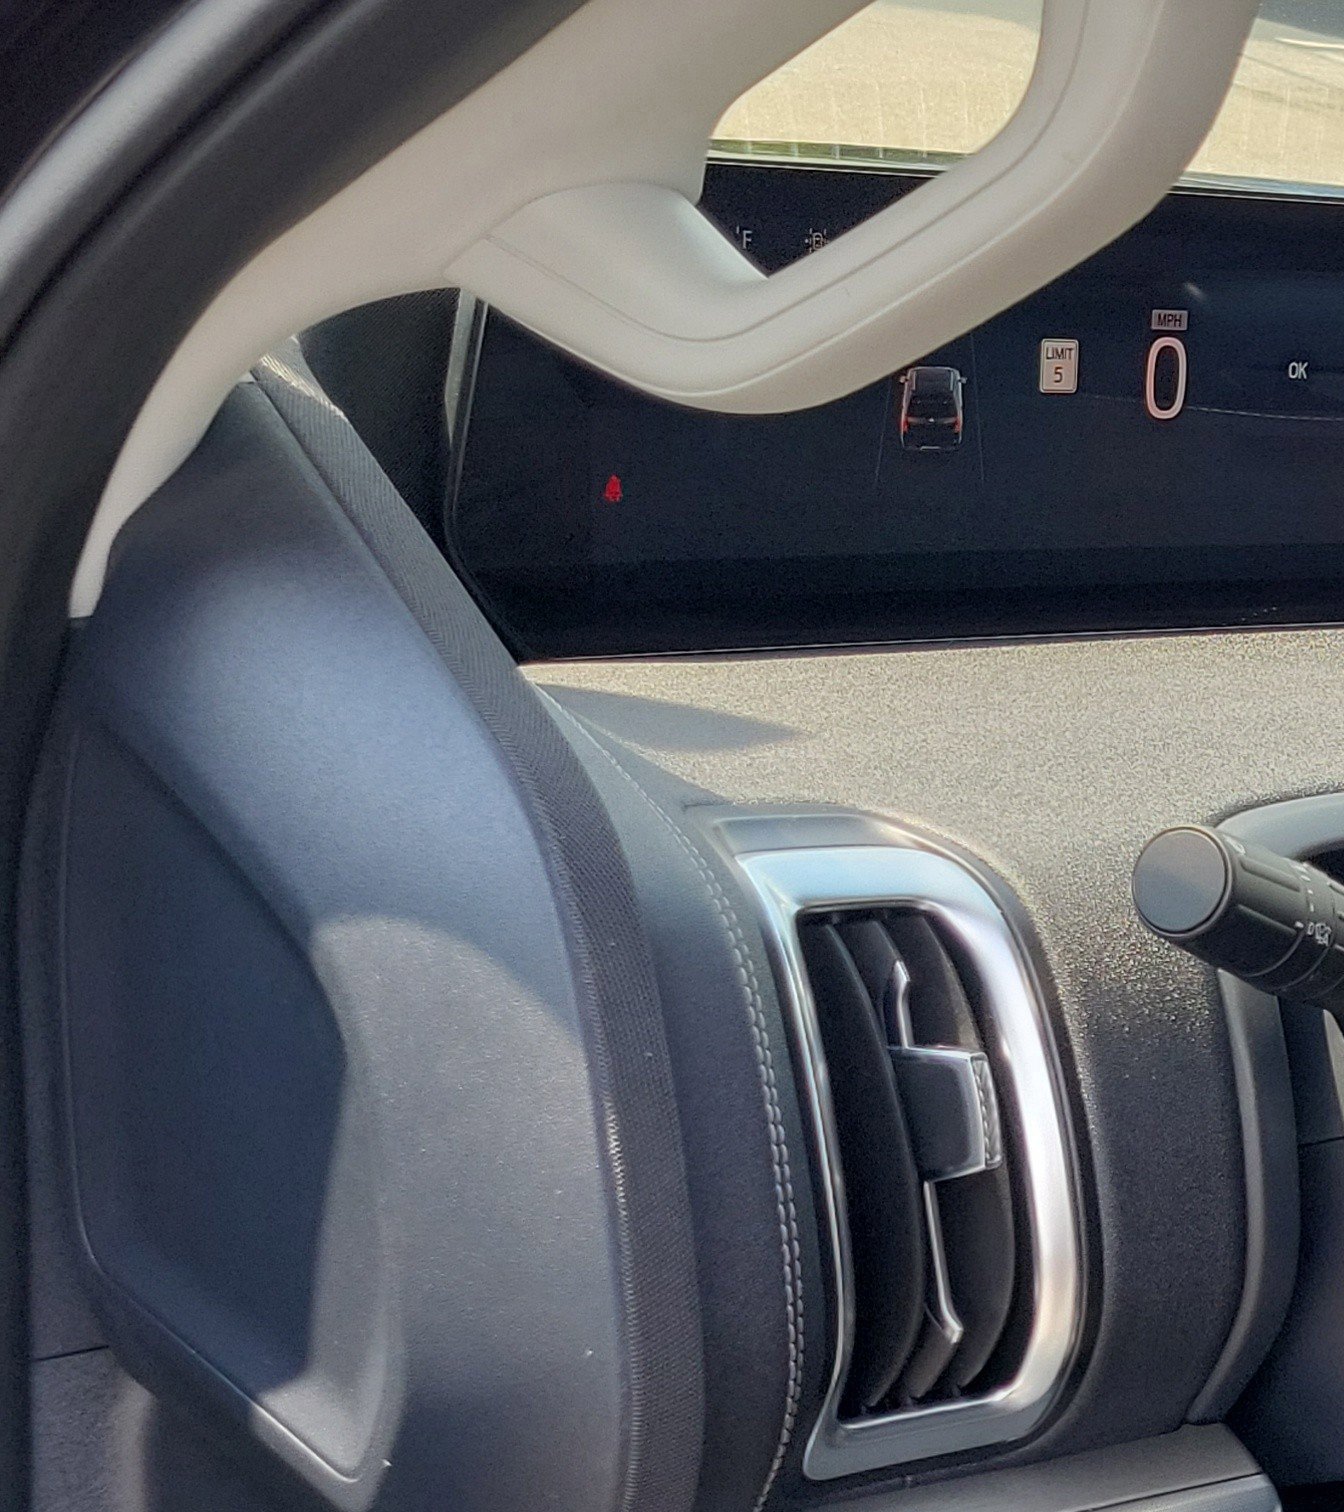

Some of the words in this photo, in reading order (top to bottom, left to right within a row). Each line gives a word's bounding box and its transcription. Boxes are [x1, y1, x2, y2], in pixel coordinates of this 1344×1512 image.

[1157, 313, 1182, 327] MPH
[1045, 346, 1075, 362] LIMIT
[1053, 366, 1063, 384] 5
[1146, 336, 1187, 420] 0
[1288, 361, 1308, 380] OK
